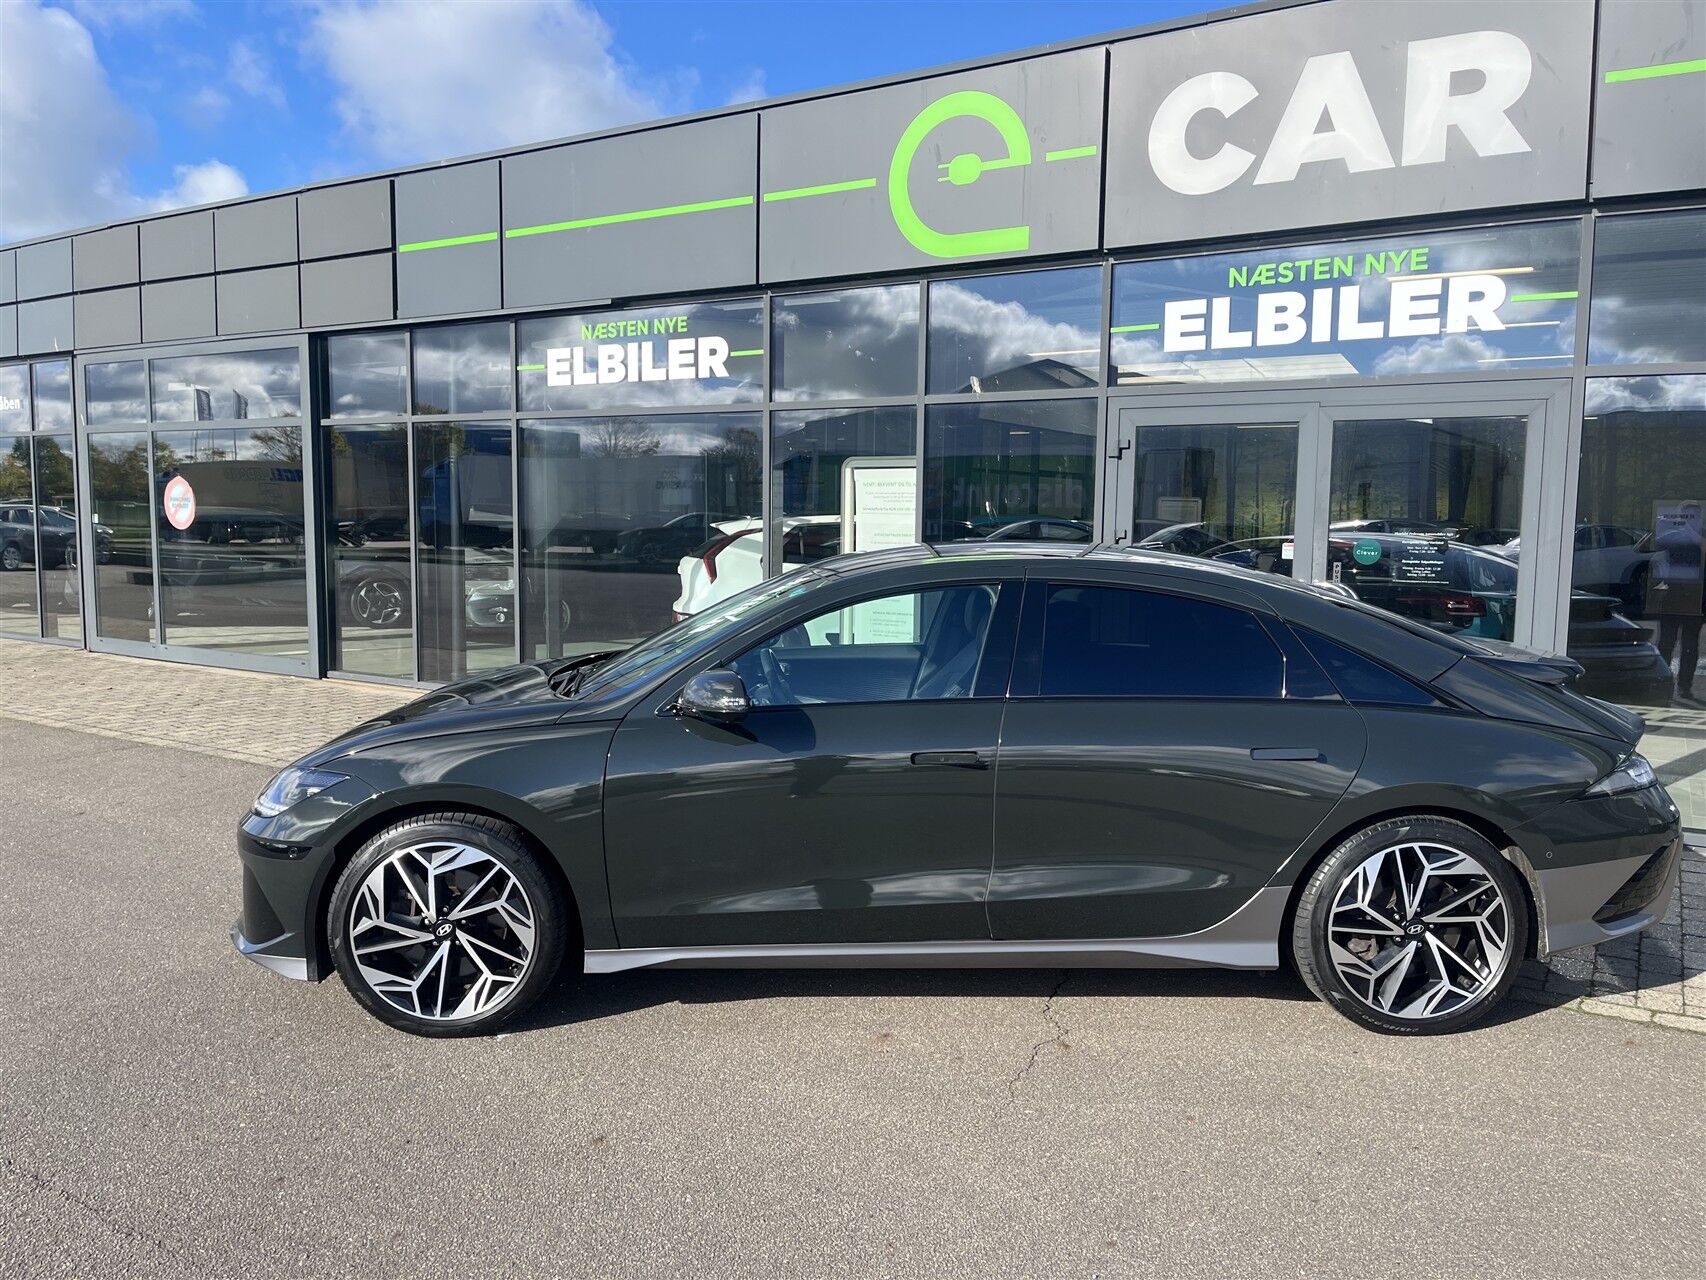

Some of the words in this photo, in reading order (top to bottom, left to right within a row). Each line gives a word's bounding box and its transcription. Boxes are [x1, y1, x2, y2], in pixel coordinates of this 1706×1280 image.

[1147, 30, 1533, 196] CAR
[1228, 255, 1355, 288] NÆSTEN
[1364, 247, 1430, 276] NYE
[581, 319, 649, 341] NÆSTEN
[653, 316, 688, 335] NYE
[1163, 273, 1508, 353] ELBILER
[546, 335, 730, 387] ELBILER
[0, 396, 20, 410] ben
